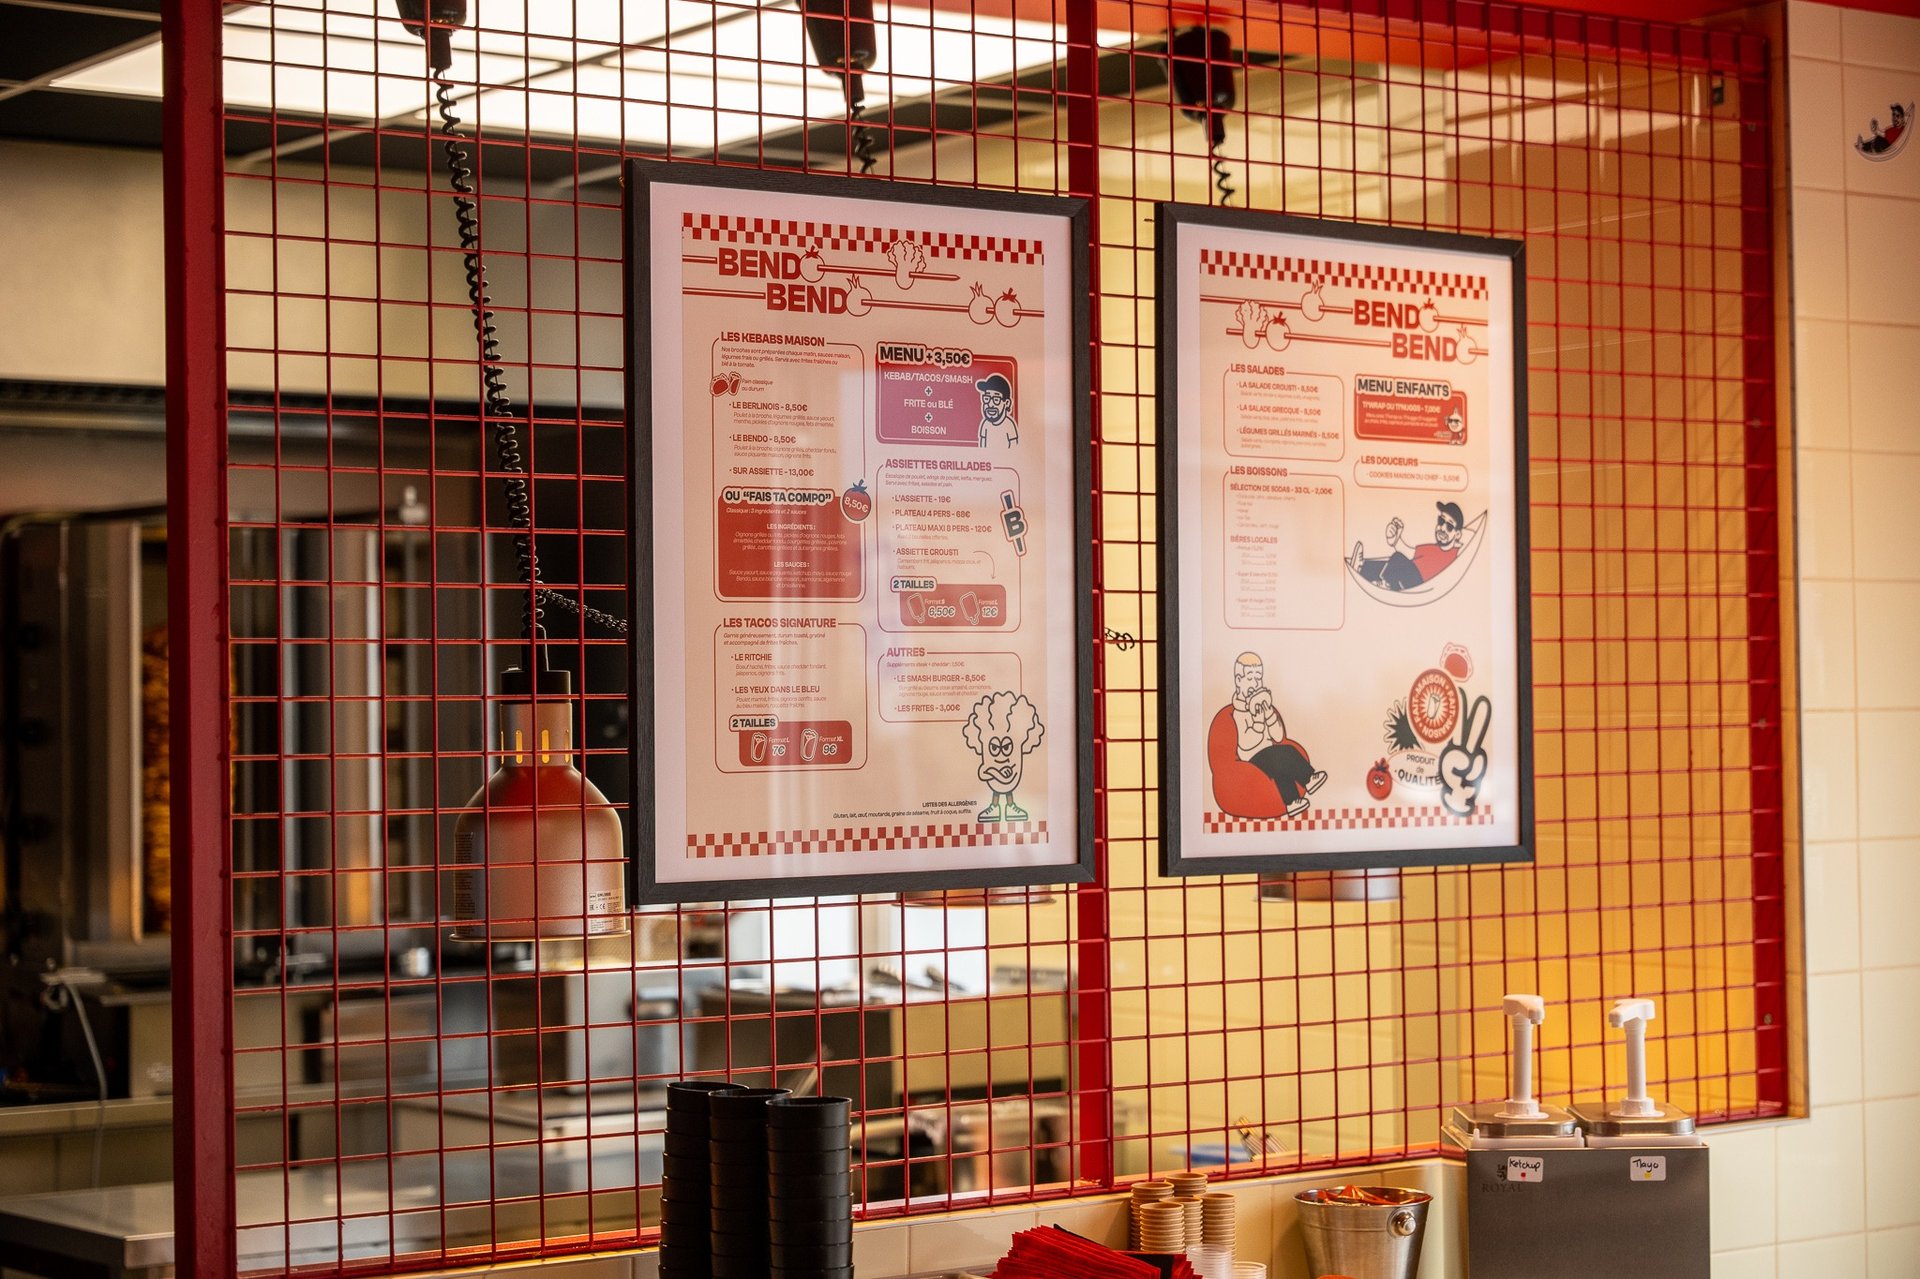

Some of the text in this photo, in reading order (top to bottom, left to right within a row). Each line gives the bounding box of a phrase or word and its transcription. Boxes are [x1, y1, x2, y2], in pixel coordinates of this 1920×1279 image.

[721, 331, 825, 347] LES KEBABS MAISON
[879, 346, 924, 362] MENU
[1230, 363, 1285, 376] LES SALADES
[884, 371, 973, 384] KEBAB/TACOS/SMASH
[1248, 382, 1271, 390] SALADE
[1271, 383, 1297, 391] CROUSTI
[1357, 378, 1450, 397] MENU ENFANTS
[732, 401, 808, 412] LE BERLINOIS 8,50€
[904, 399, 926, 408] FRITE
[938, 399, 953, 409] BLÉ
[1248, 405, 1271, 413] SALADE
[1272, 406, 1299, 415] GRECQUE
[911, 425, 947, 435] BOISSON
[732, 434, 797, 444] LE BENDO 8,50€
[885, 459, 992, 472] ASSIETTES GRILLADES
[1360, 455, 1418, 467] LES DOUCEURS
[733, 467, 815, 477] SUR ASSIETTE 13,00€
[1230, 465, 1288, 477] LES BOISSONS
[1262, 484, 1271, 492] DE
[1271, 485, 1290, 493] SODAS
[725, 491, 740, 501] OU
[773, 492, 786, 502] TA
[895, 494, 951, 503] L'ASSIETTE 19€
[844, 496, 869, 514] 8,50€
[895, 510, 927, 518] PLATEAU
[927, 510, 932, 518] 4
[933, 510, 951, 518] PERS
[895, 524, 927, 532] PLATEAU
[896, 548, 929, 556] ASSIETTE
[893, 580, 935, 589] 2 TAILLES
[928, 607, 955, 618] 6,50€
[982, 607, 998, 617] 12€
[723, 617, 837, 628] LES TACOS SIGNATURE
[734, 653, 772, 661] LE RITCHIE
[886, 647, 926, 657] AUTRES
[932, 674, 960, 682] BURGER
[964, 674, 986, 683] 8,50€
[735, 686, 749, 694] LES
[801, 685, 820, 693] BLEU
[897, 704, 960, 712] LES FRITES 3,00€
[732, 718, 776, 728] 2 TAILLES
[772, 745, 785, 755] 7€
[823, 744, 837, 755] 9€
[1406, 754, 1435, 765] PRODUIT
[1509, 1159, 1541, 1173] Ketchup
[1481, 1183, 1523, 1193] ROYAL
